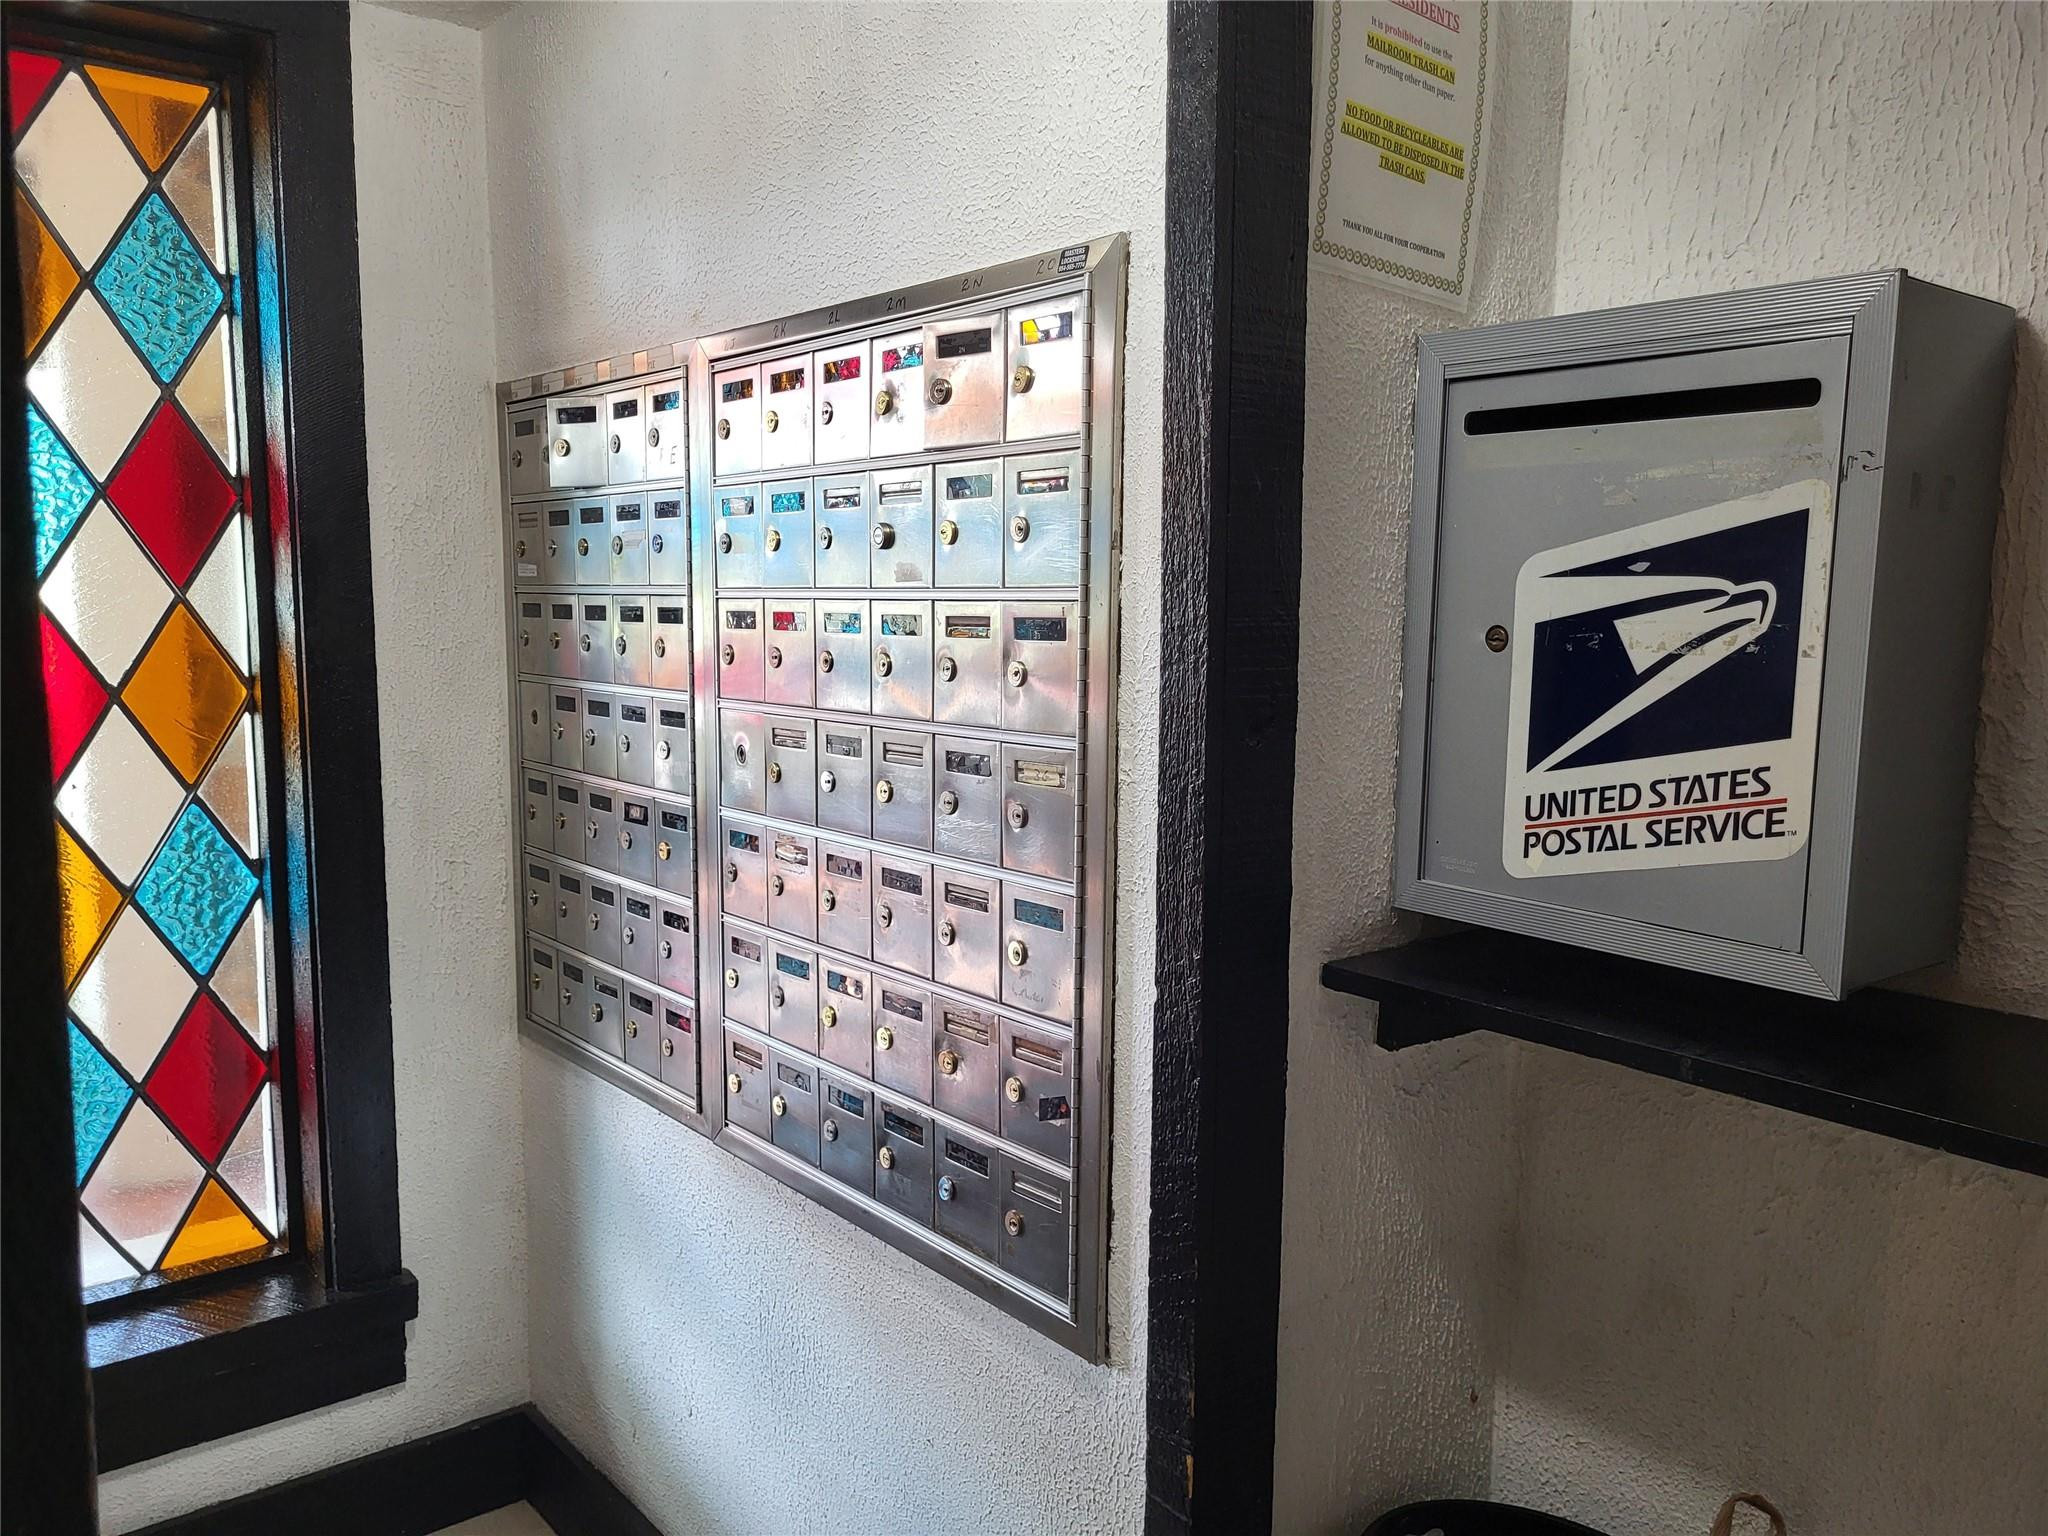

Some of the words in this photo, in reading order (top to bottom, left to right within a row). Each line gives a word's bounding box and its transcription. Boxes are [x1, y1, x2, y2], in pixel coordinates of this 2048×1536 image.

[1394, 0, 1460, 31] ESIDENTS
[1367, 34, 1411, 67] MAILROOM
[1413, 55, 1438, 77] TRASH
[1440, 68, 1455, 83] CAN
[1385, 23, 1423, 48] prohibited
[1424, 40, 1430, 51] to
[1431, 45, 1441, 56] use
[1442, 49, 1453, 61] the
[1365, 54, 1374, 67] for
[1376, 61, 1403, 81] anything
[1404, 71, 1421, 87] other
[1422, 80, 1436, 94] than
[1437, 87, 1455, 102] paper.
[1341, 121, 1379, 144] ALLOWED
[1382, 137, 1392, 149] TO
[1394, 143, 1403, 154] BE
[1405, 146, 1440, 168] DISPOSED
[1441, 161, 1449, 172] IN
[1450, 164, 1464, 178] THE
[1346, 103, 1358, 117] NO
[1360, 108, 1380, 124] FOOD
[1383, 118, 1394, 130] OR
[1394, 123, 1448, 153] RECYCLEABLES
[1450, 146, 1464, 160] ARE
[1380, 155, 1403, 174] TRASH
[1405, 166, 1425, 182] CANS
[1342, 218, 1361, 232] THANK
[1362, 225, 1373, 236] YOU
[1374, 229, 1383, 239] ALL
[1383, 233, 1394, 243] FOR
[1394, 237, 1408, 248] YOUR
[1409, 241, 1445, 259] COOPERATION
[961, 274, 983, 292] 2N
[772, 322, 787, 339] 2K
[827, 310, 841, 326] 2L
[1525, 783, 1641, 821] UNITED
[1648, 766, 1771, 809] STATES
[1523, 823, 1637, 858] POSTAL
[1645, 807, 1787, 849] SERVICE
